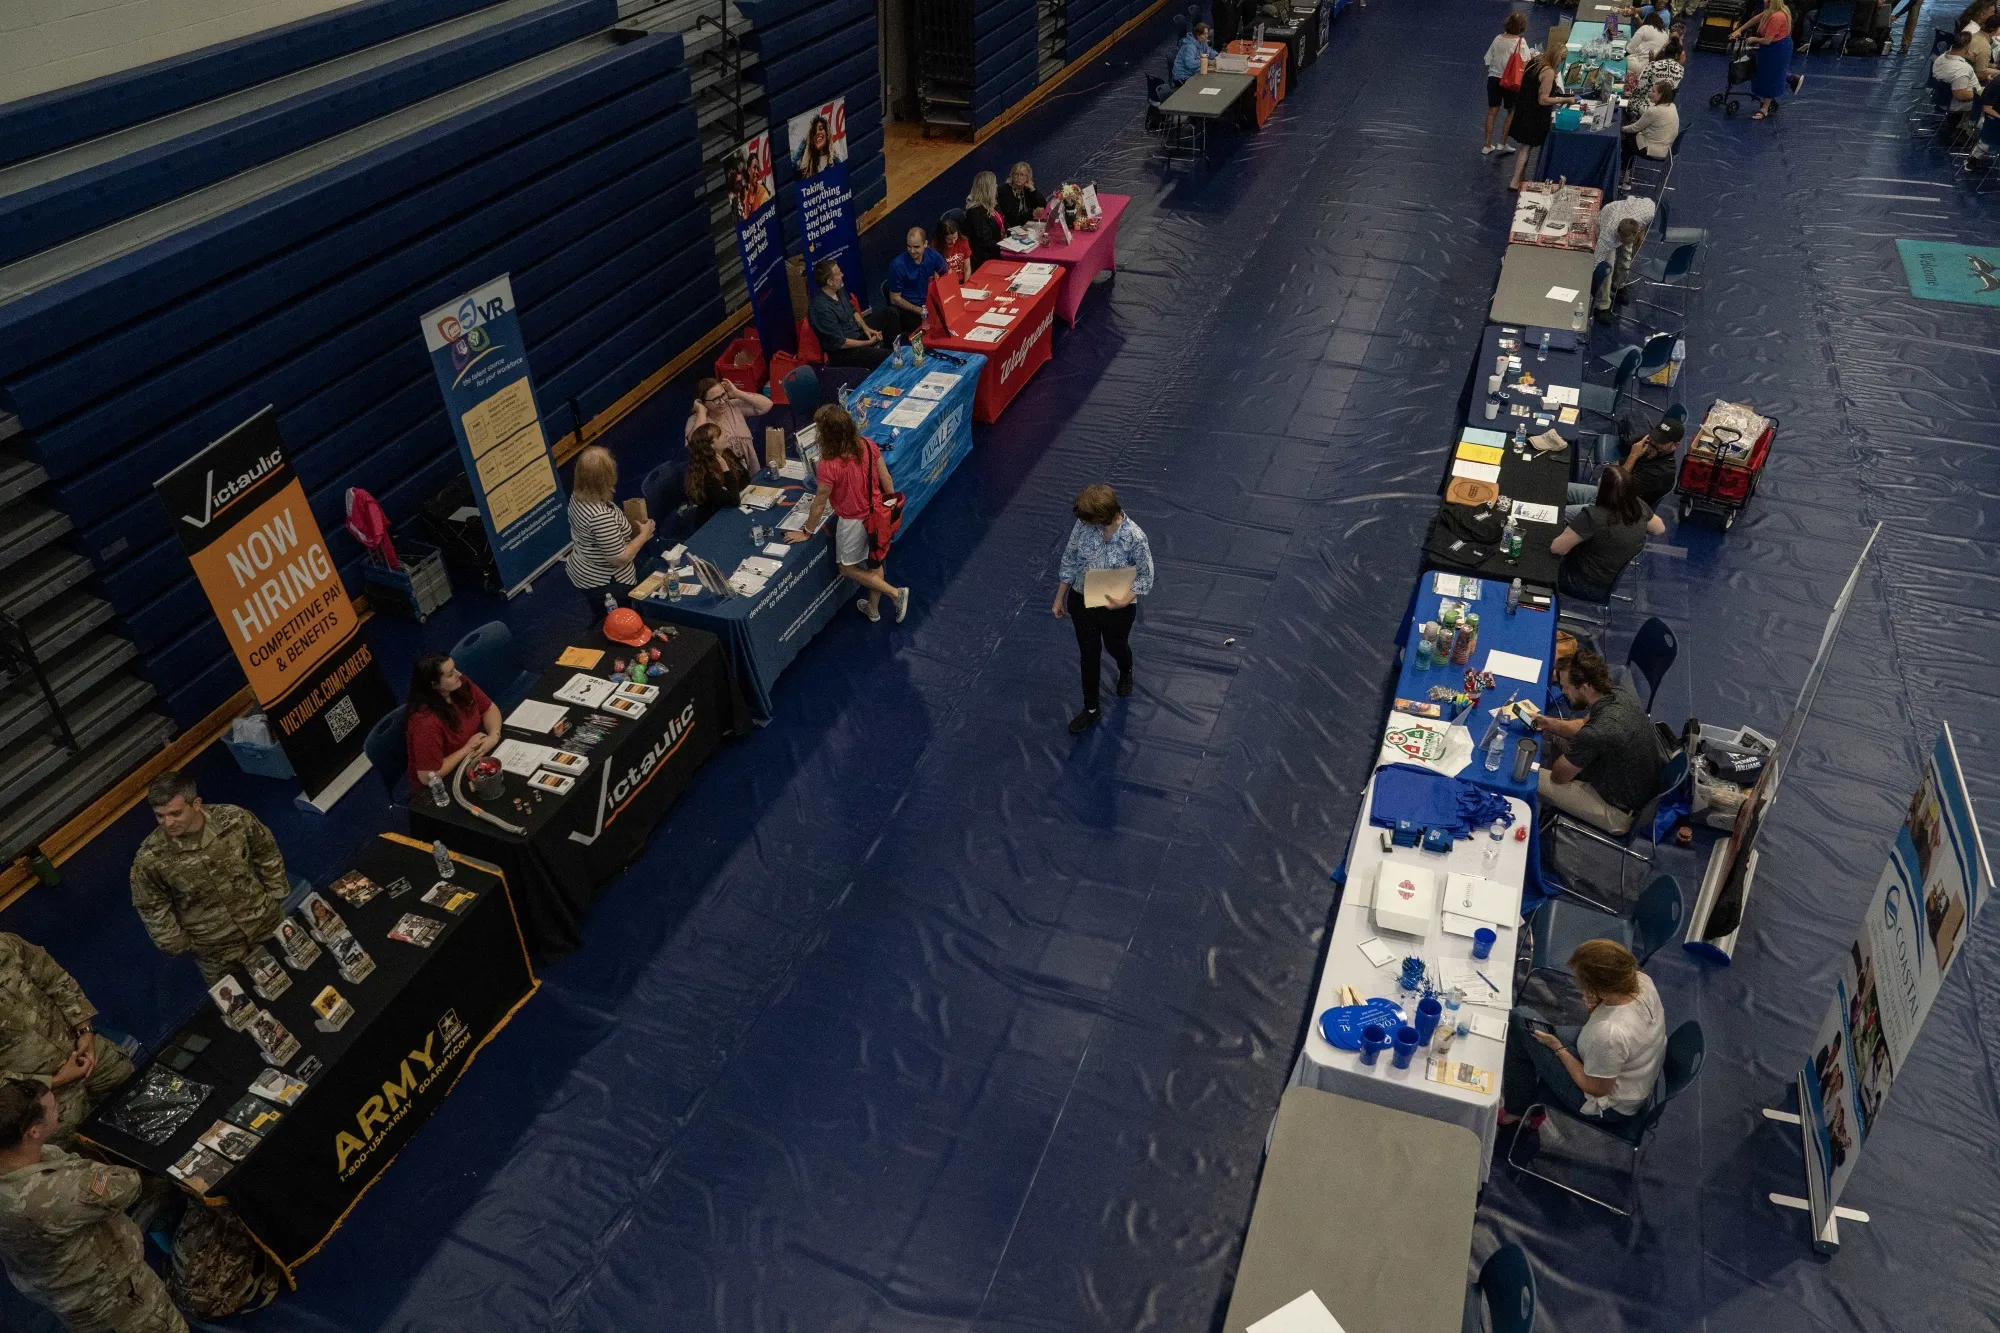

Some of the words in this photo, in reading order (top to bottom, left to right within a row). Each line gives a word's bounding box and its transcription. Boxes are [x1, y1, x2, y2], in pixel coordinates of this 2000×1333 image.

[801, 181, 824, 197] Taking
[803, 186, 840, 208] everything
[804, 202, 826, 221] you've
[828, 188, 852, 208] learned
[806, 217, 820, 230] and
[820, 208, 842, 222] taking
[742, 223, 756, 240] Being
[756, 204, 776, 230] yourself
[744, 236, 754, 252] and
[807, 230, 820, 241] the
[820, 220, 836, 235] lead.
[1918, 253, 1938, 287] Welcome
[477, 296, 506, 320] VR
[471, 366, 487, 380] talent
[487, 358, 504, 371] source
[486, 371, 496, 383] your
[497, 357, 523, 376] workforce
[1000, 306, 1054, 384] Walgreens
[180, 449, 283, 529] Victaulic
[226, 508, 298, 589] NOW
[769, 600, 775, 609] to
[776, 586, 789, 602] meet
[789, 566, 809, 589] industry
[809, 544, 827, 568] demand
[232, 544, 332, 643] HIRING
[249, 598, 324, 667] COMPETITIVE
[322, 580, 342, 607] PAY
[749, 586, 777, 619] developing
[778, 572, 792, 590] talent
[276, 657, 288, 672] &
[286, 612, 338, 663] BENEFITS
[279, 643, 373, 736] VICTAULIC.COM/CAREERS
[568, 703, 694, 846] Victaulic
[1896, 927, 1919, 1025] COASTAL
[418, 1031, 472, 1094] GOARMY.COM
[335, 1030, 434, 1174] ARMY
[339, 1098, 413, 1182] 1-800-USA-ARMY
